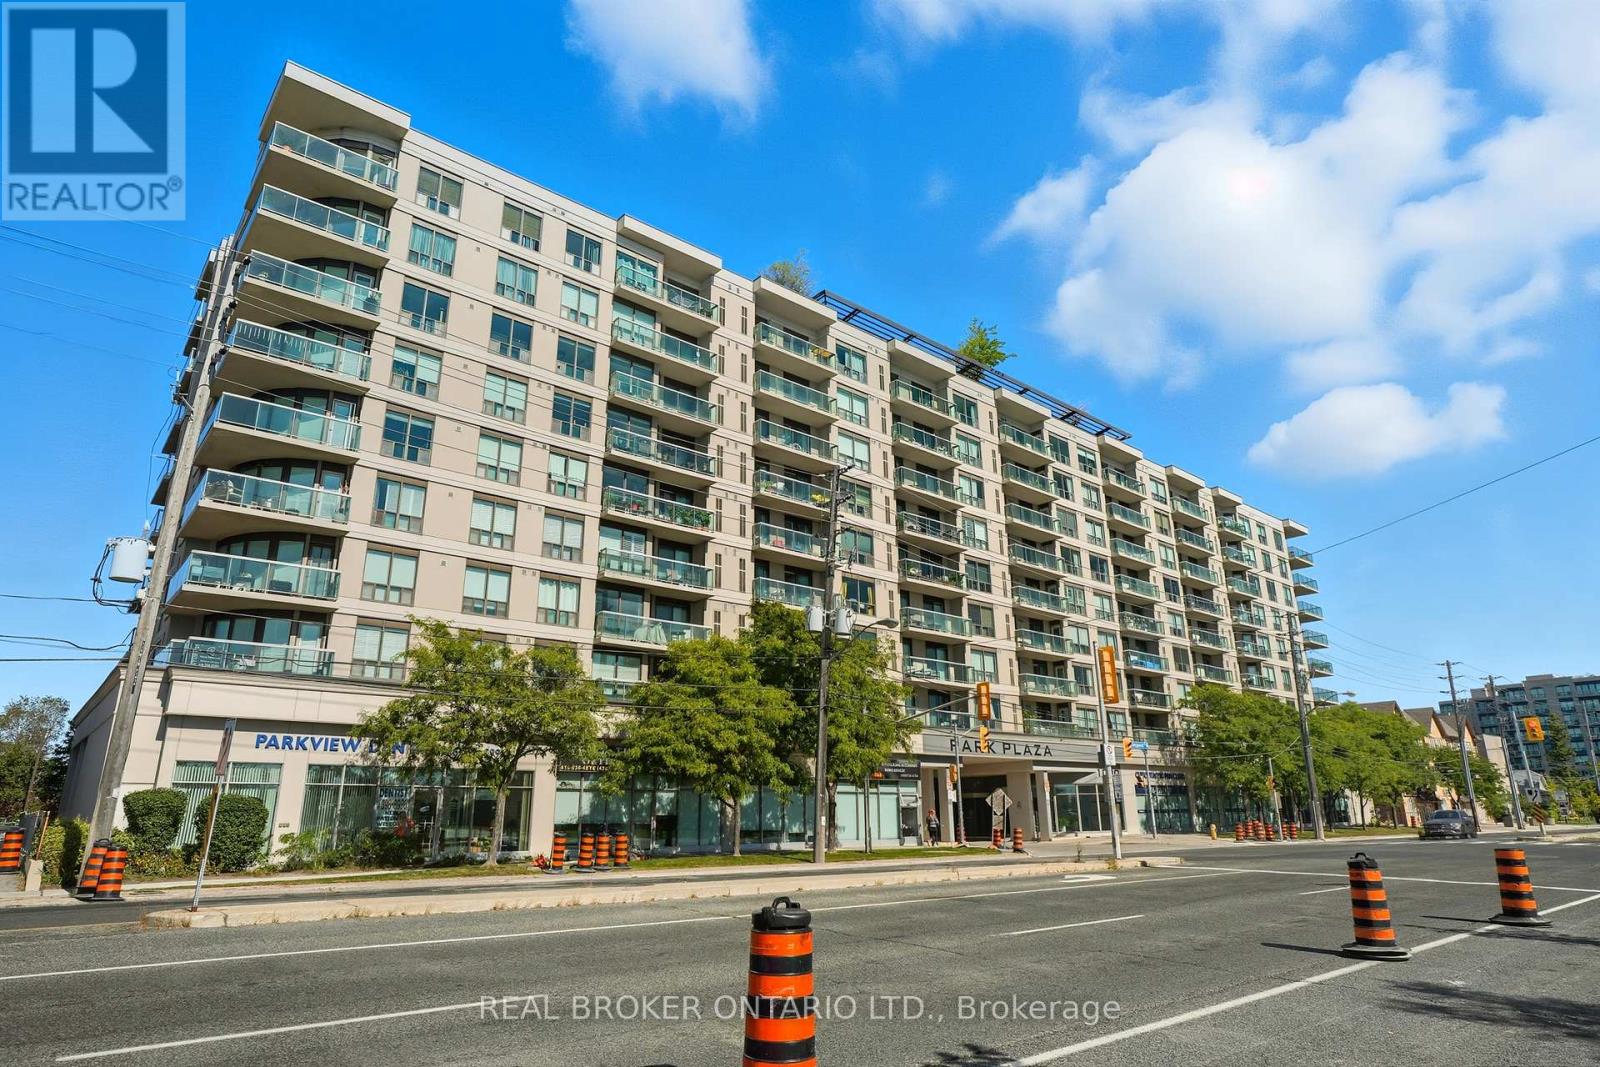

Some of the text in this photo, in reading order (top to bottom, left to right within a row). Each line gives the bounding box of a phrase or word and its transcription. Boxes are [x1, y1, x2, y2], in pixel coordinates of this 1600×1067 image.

[255, 734, 361, 753] PARKVIEW
[950, 739, 1053, 757] PARK PLAZA
